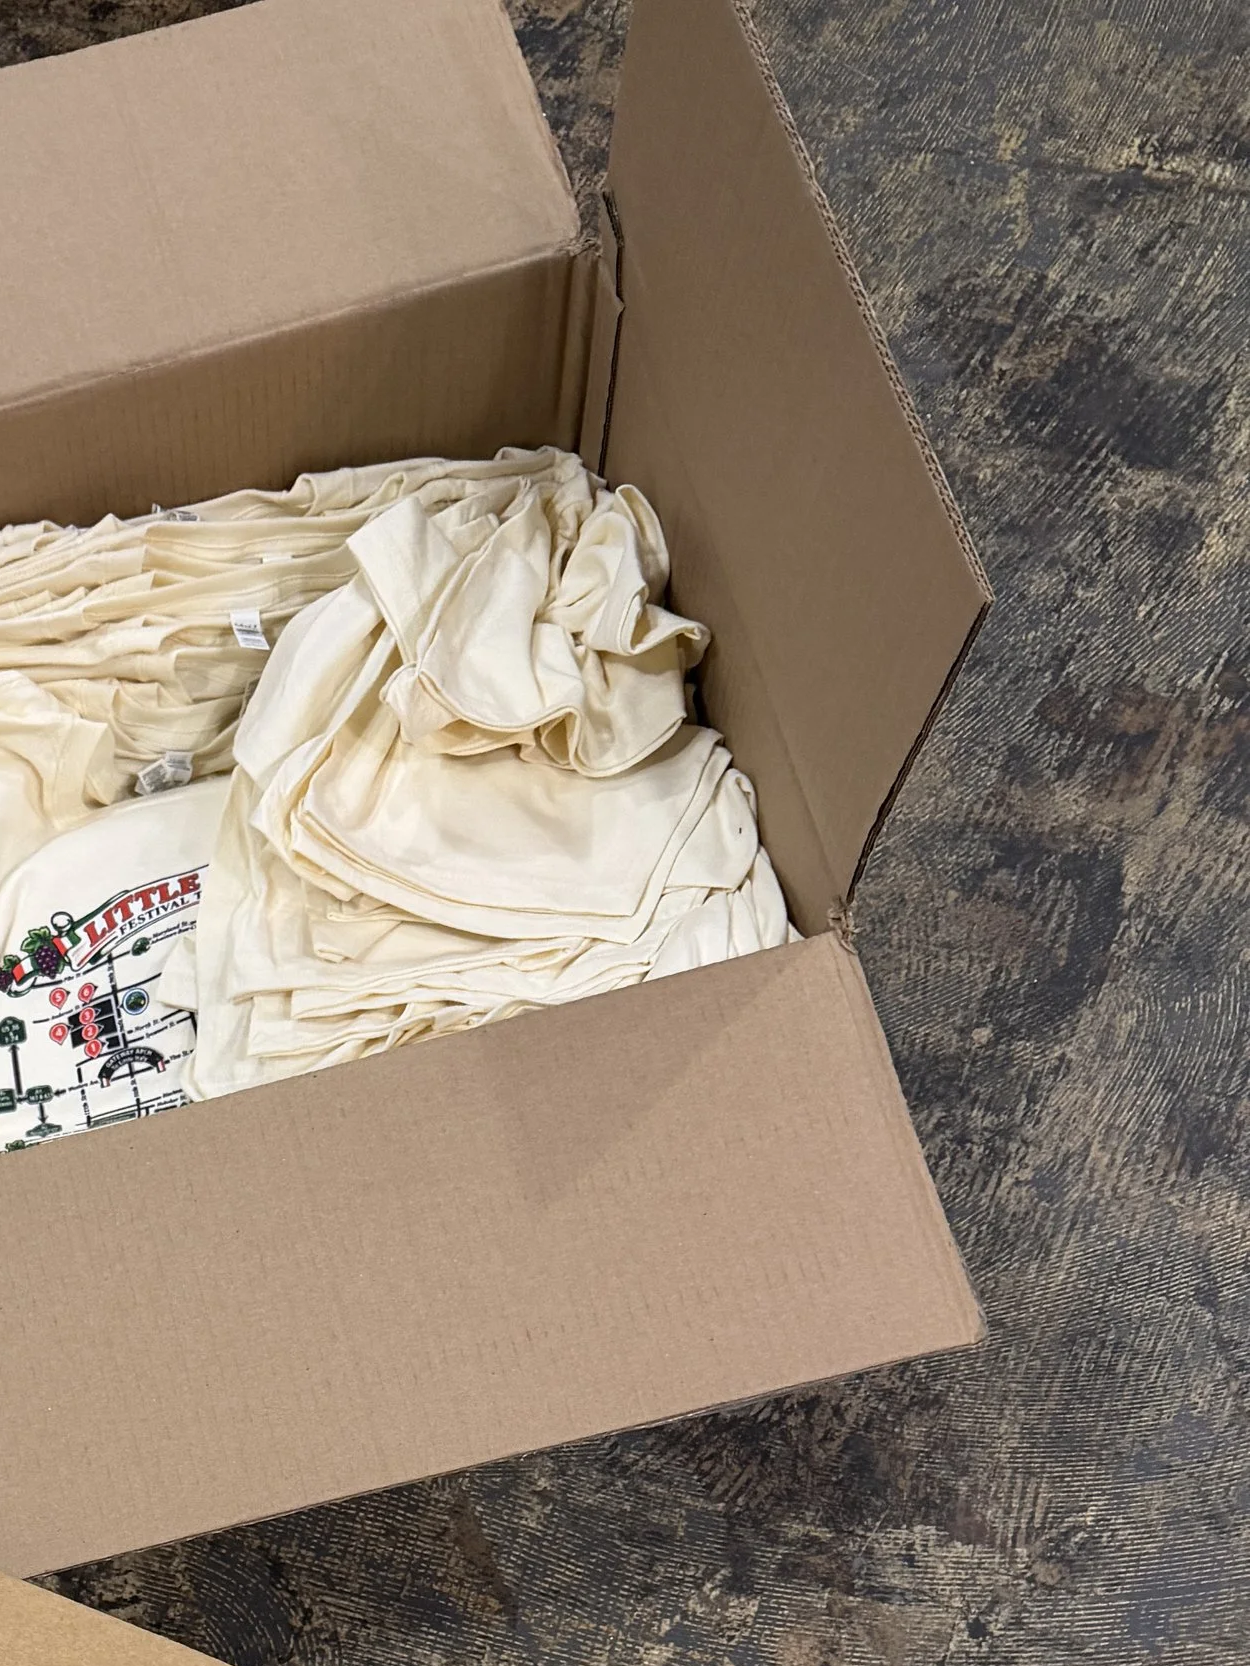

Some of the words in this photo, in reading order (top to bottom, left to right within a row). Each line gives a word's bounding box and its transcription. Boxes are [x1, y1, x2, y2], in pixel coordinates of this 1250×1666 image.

[82, 873, 201, 947] LITTLE
[119, 898, 190, 935] FESTIVAL
[55, 993, 62, 1003] 5
[83, 989, 90, 997] 6
[83, 1012, 90, 1021] 3
[55, 1029, 63, 1037] 4
[87, 1027, 94, 1037] 2
[91, 1043, 97, 1053] 1
